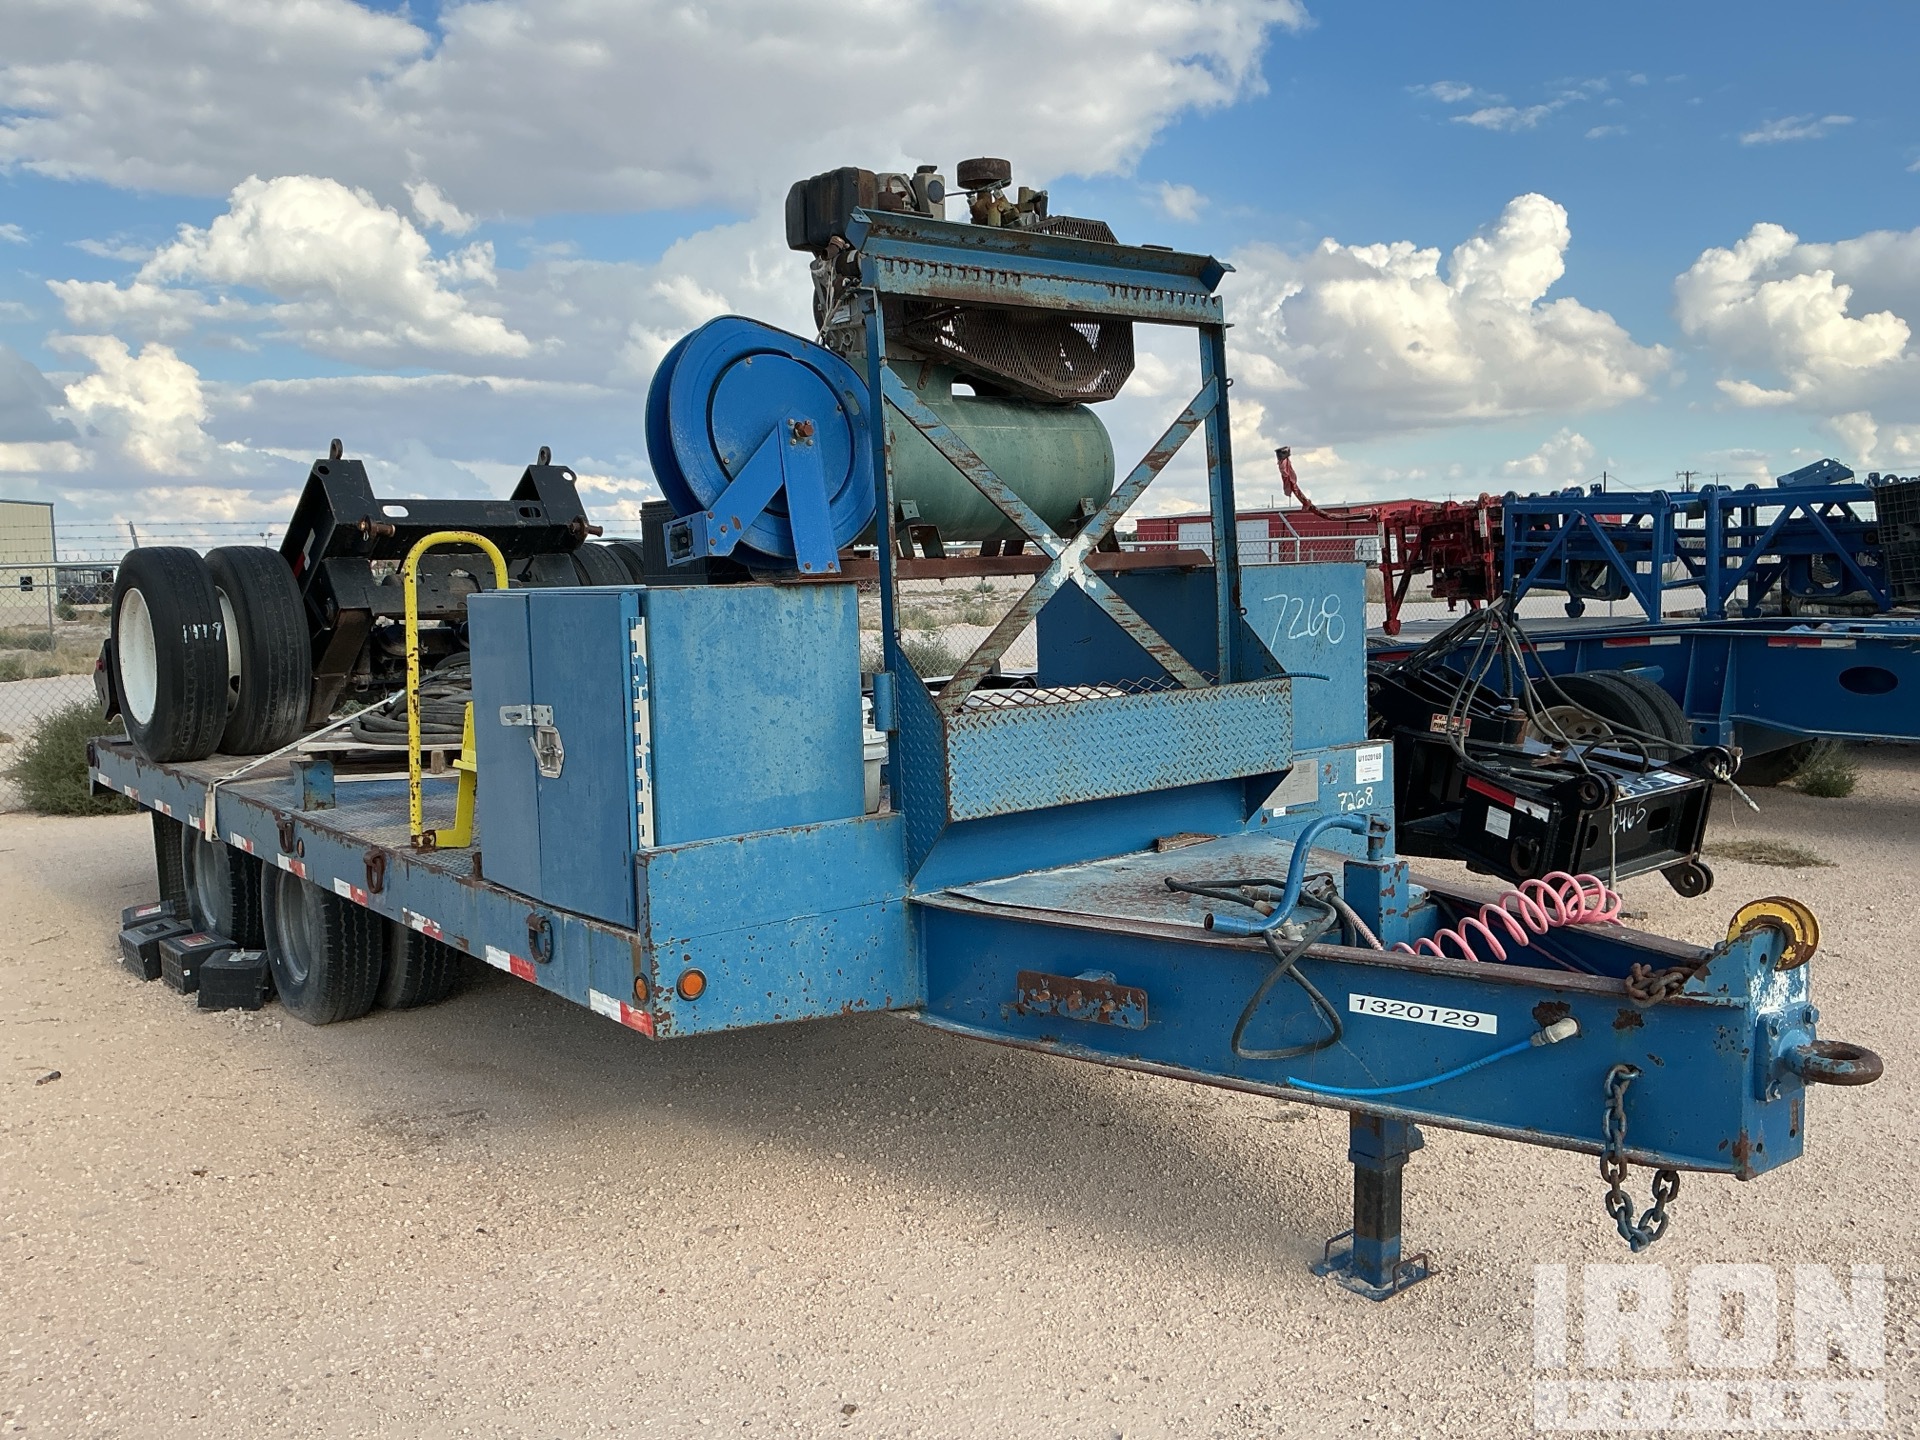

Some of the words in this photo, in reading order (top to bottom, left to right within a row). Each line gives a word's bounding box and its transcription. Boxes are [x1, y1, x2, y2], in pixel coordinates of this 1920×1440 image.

[1263, 593, 1346, 652] 7268
[1337, 786, 1374, 812] 7268
[1355, 997, 1480, 1028] 1320129
